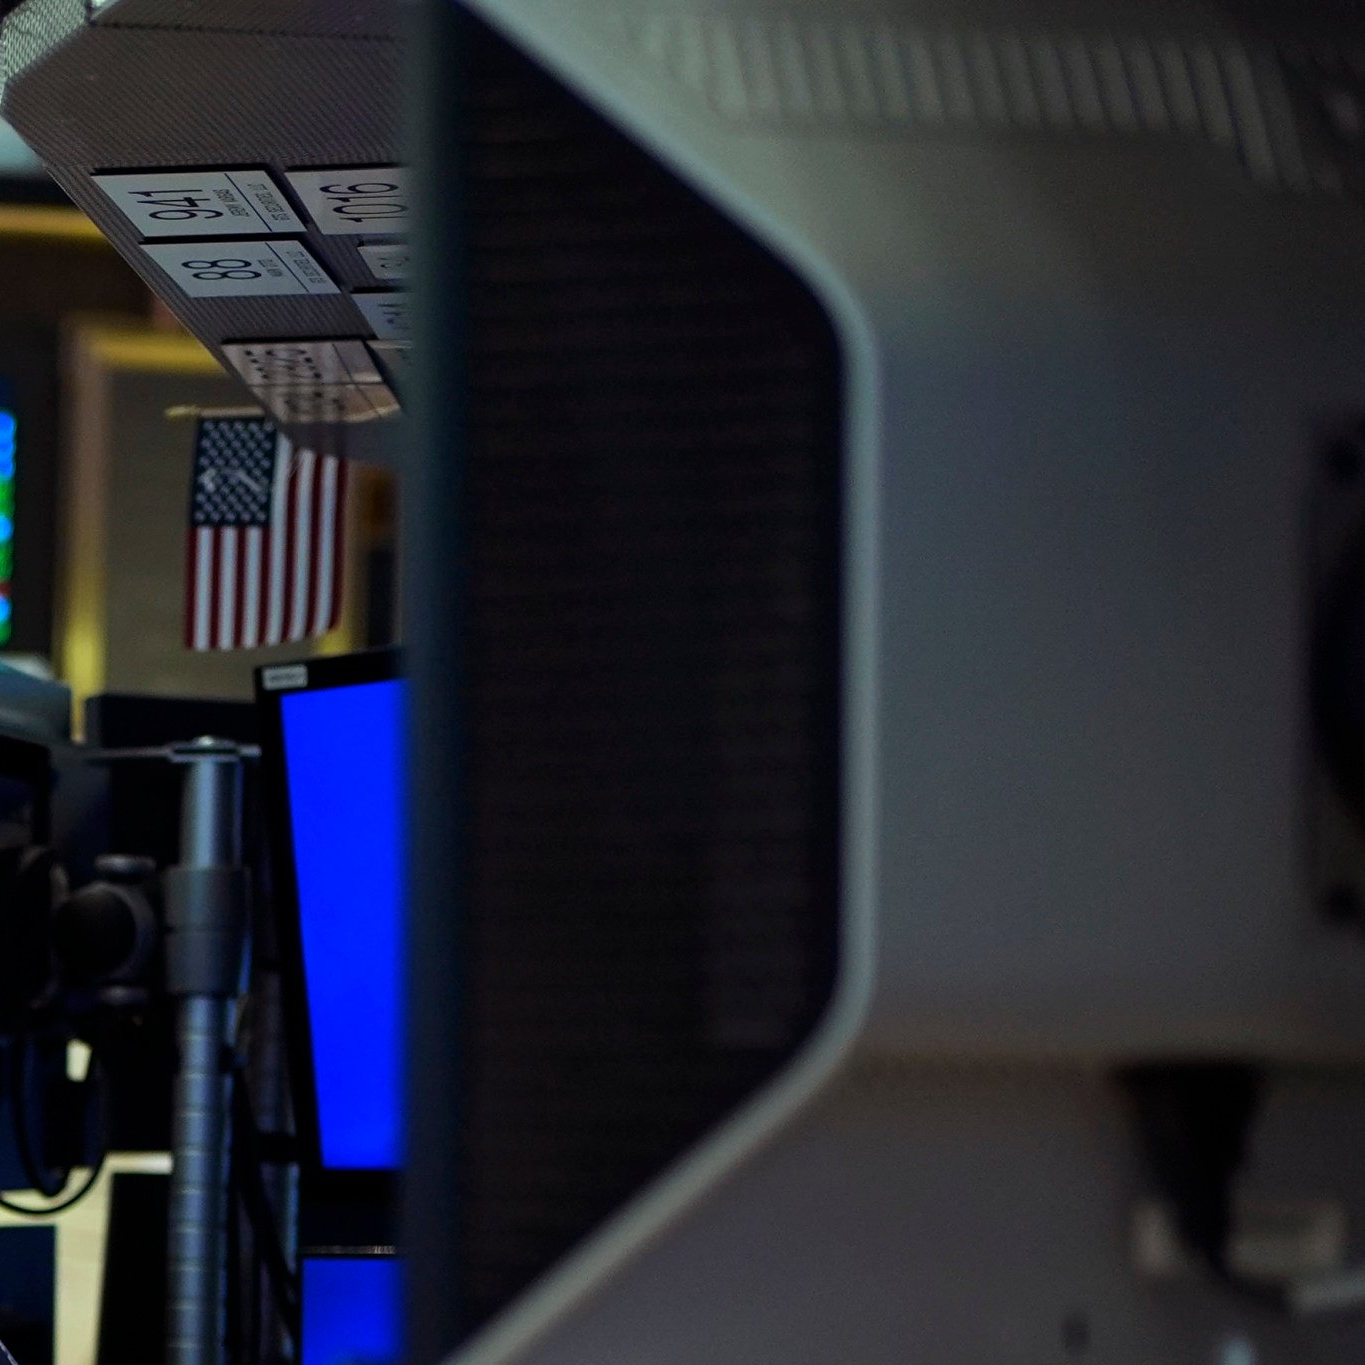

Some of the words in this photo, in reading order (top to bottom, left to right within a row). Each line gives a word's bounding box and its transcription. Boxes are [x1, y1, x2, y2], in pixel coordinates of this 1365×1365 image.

[128, 188, 224, 221] 941
[319, 182, 409, 223] 1016
[181, 258, 262, 281] 88
